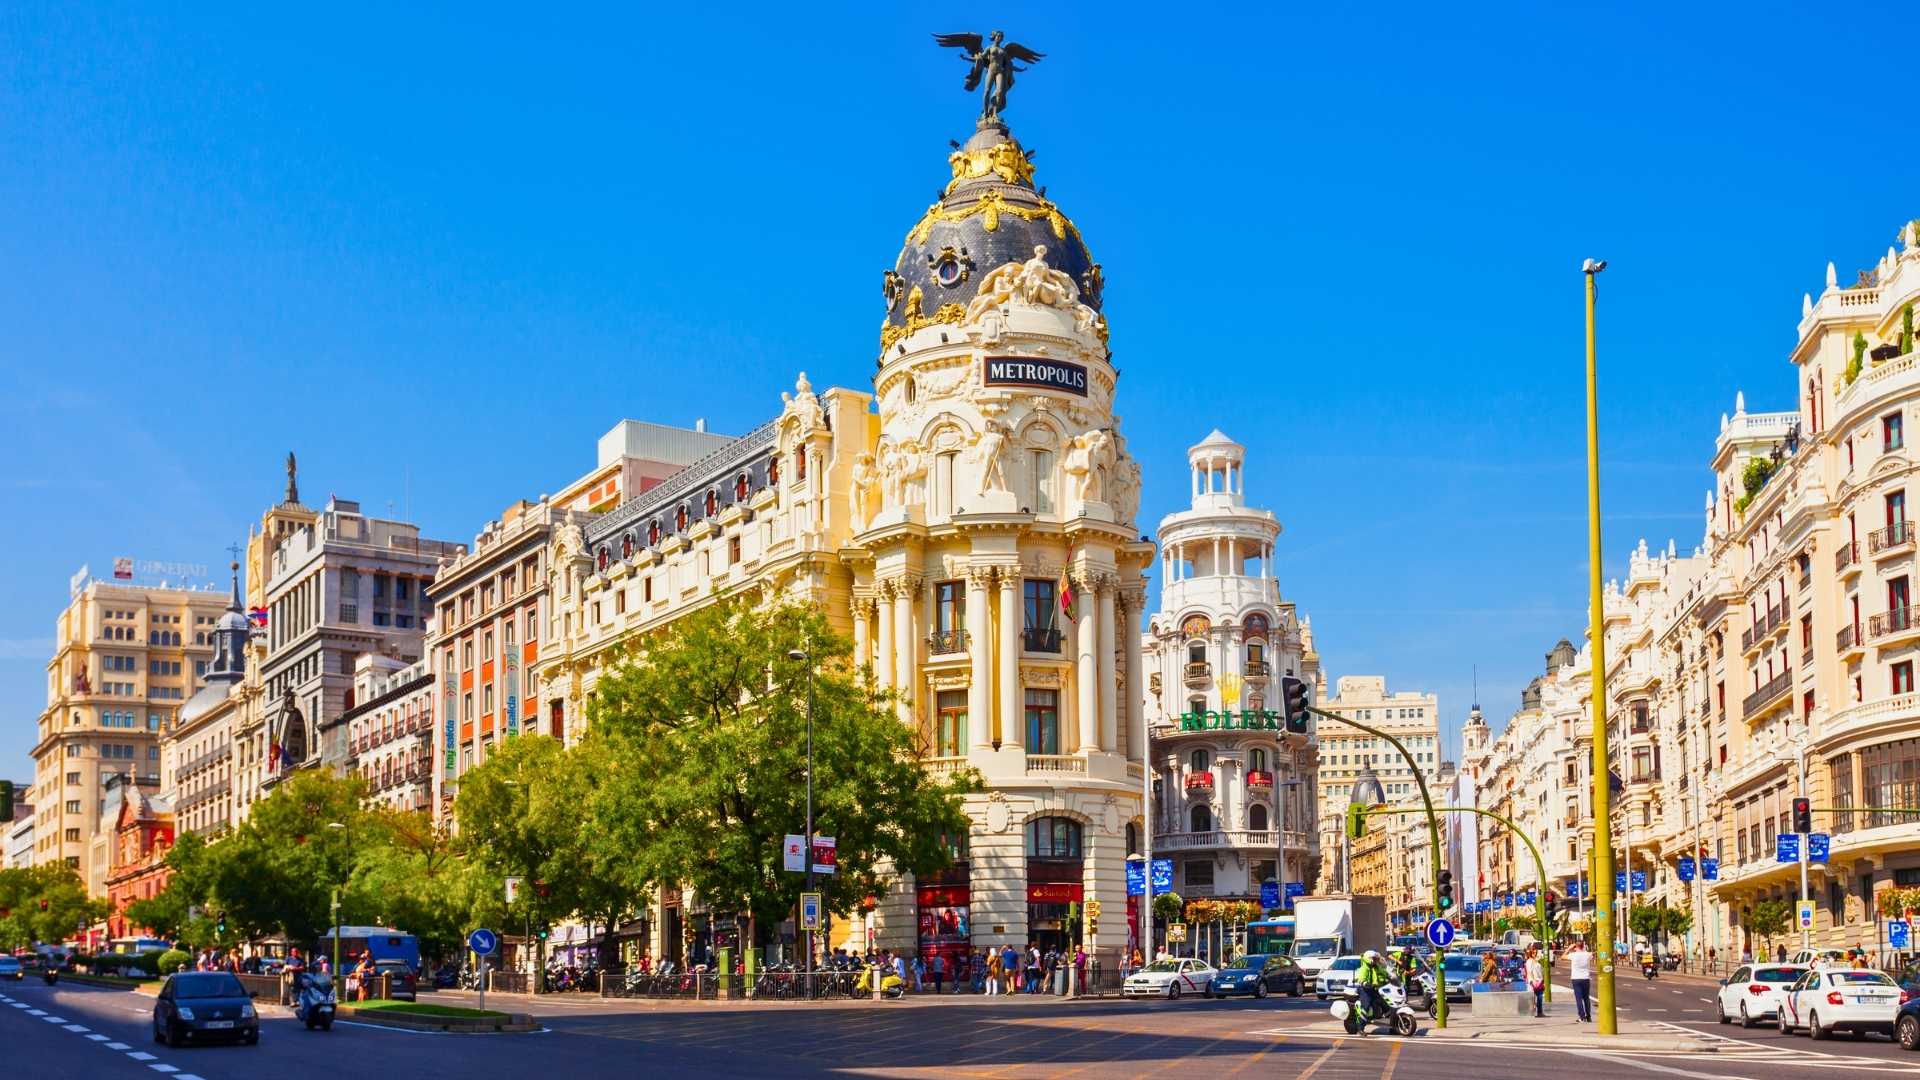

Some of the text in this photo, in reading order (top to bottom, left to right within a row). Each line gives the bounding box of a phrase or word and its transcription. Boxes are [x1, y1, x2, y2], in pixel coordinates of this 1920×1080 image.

[991, 363, 1084, 388] METROPOLIS
[1179, 711, 1280, 731] ROLEX
[1891, 923, 1902, 937] P
